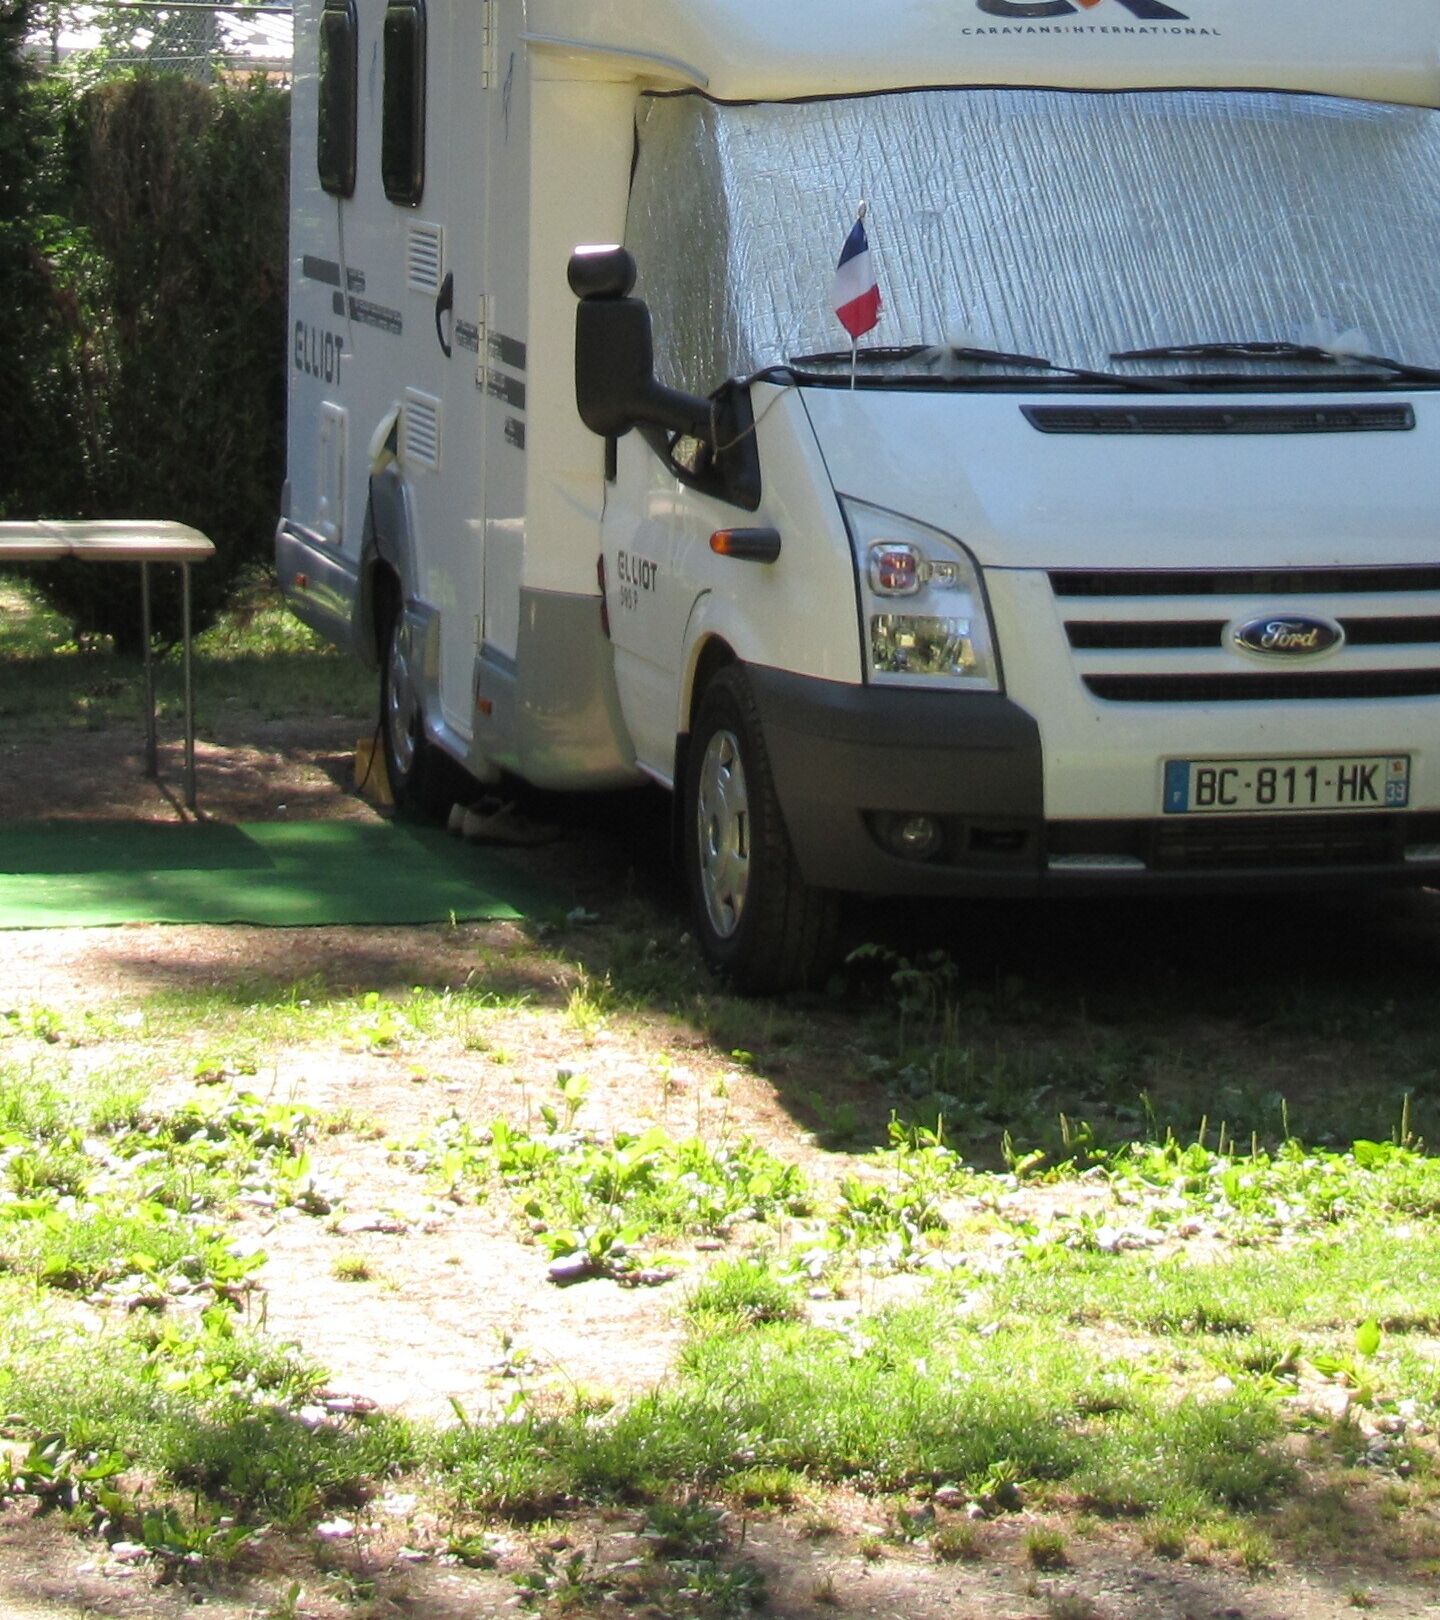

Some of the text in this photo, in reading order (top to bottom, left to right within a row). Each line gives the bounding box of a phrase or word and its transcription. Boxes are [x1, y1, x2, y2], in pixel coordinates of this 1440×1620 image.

[295, 320, 344, 386] ELLIOT
[618, 550, 657, 592] ELLIOT
[1261, 621, 1318, 648] Ford
